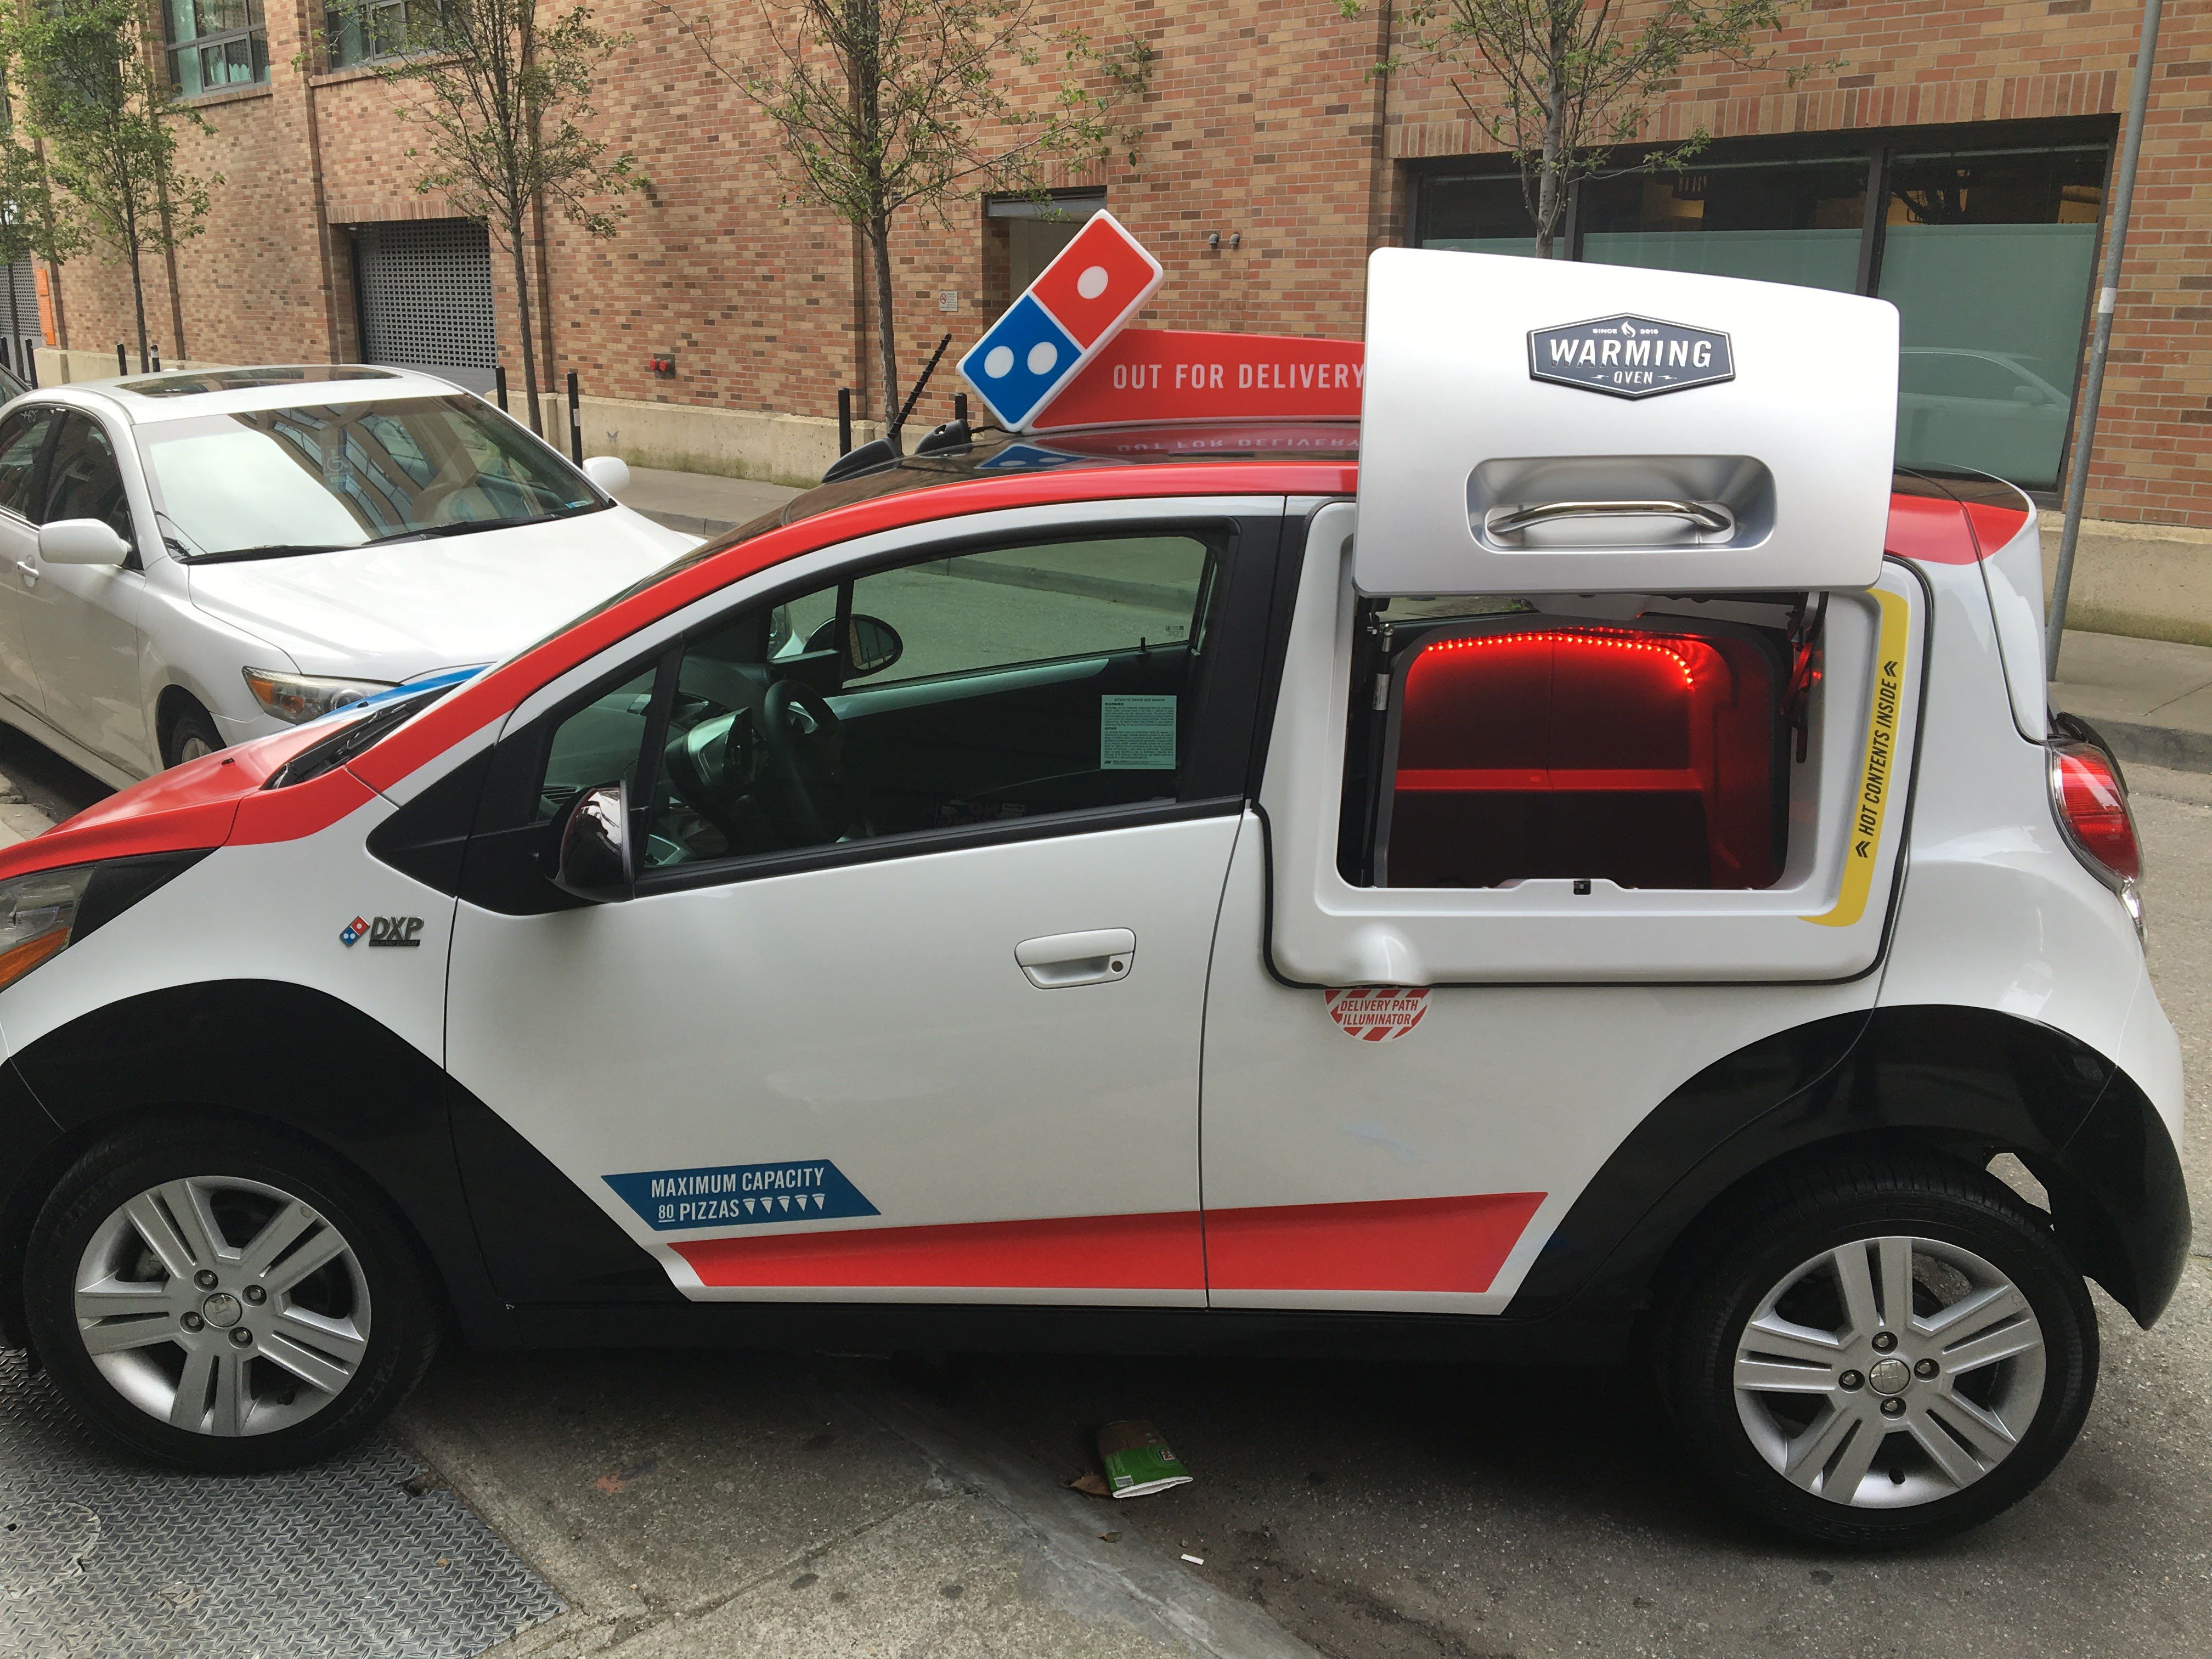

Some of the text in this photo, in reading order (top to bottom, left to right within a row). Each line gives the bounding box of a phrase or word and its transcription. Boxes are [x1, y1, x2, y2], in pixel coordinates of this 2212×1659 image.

[1550, 339, 1712, 368] WARMING
[1114, 363, 1364, 390] OUT FOR DELIVERY
[1613, 371, 1654, 385] OVEN
[1858, 679, 1897, 836] HOT CONTENTS INSIDE
[370, 916, 425, 940] DXP
[1340, 1000, 1418, 1012] DELIVERY PATH
[1343, 1014, 1412, 1025] ILLUMINATOR
[651, 1167, 825, 1198] MAXIMUM CAPACITY
[658, 1199, 740, 1221] 80 PIZZAS
